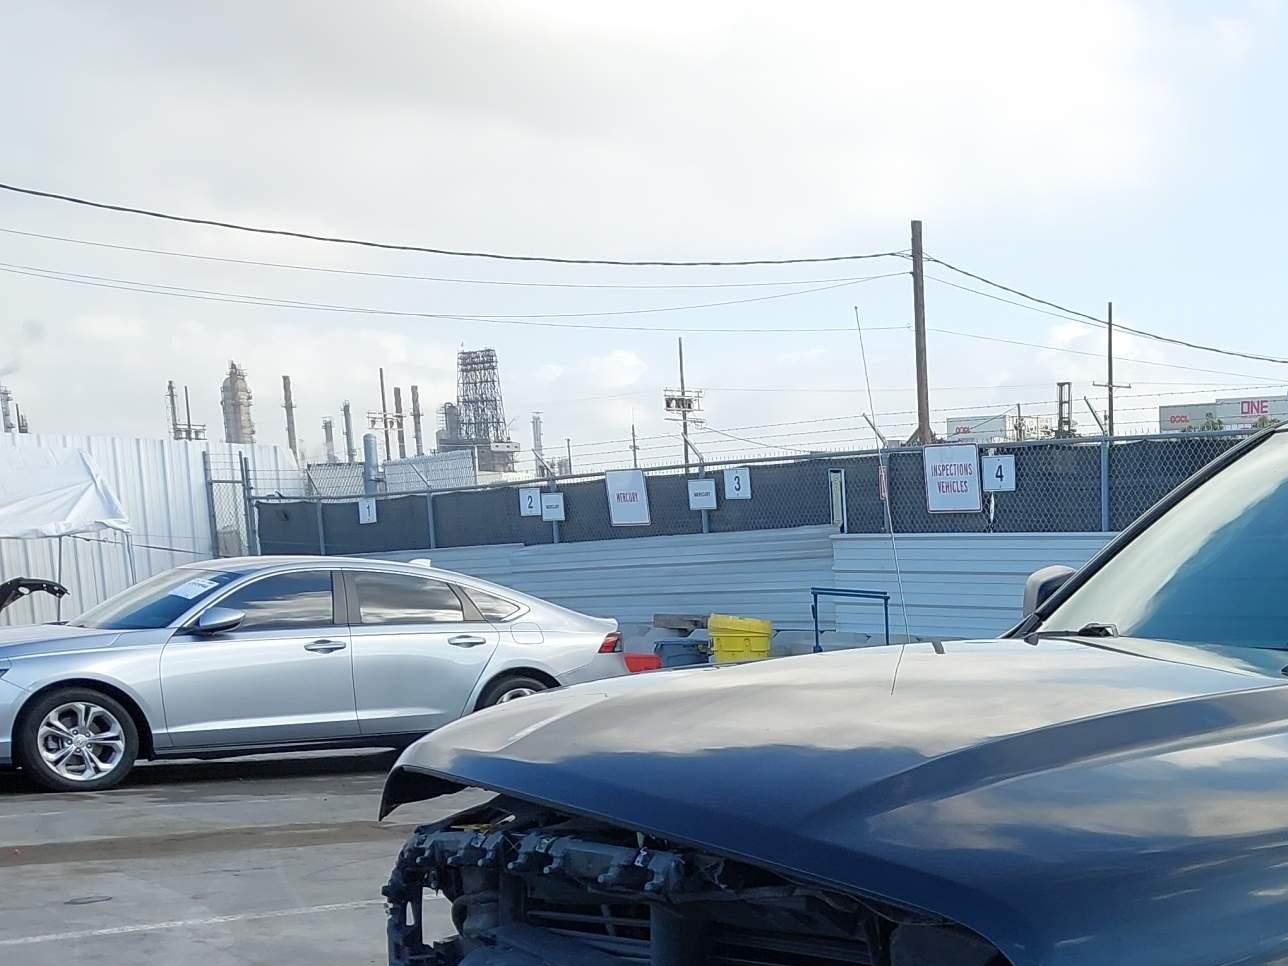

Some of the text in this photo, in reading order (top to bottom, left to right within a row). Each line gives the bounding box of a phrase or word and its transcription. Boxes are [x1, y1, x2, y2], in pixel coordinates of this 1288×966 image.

[1240, 400, 1269, 415] ONE
[931, 463, 973, 477] INSPECTIONS
[995, 464, 1004, 482] 4
[734, 475, 741, 492] 3
[937, 480, 968, 494] VEHICLES
[527, 495, 534, 509] 2
[616, 492, 639, 503] MERCURY
[365, 505, 371, 517] 1
